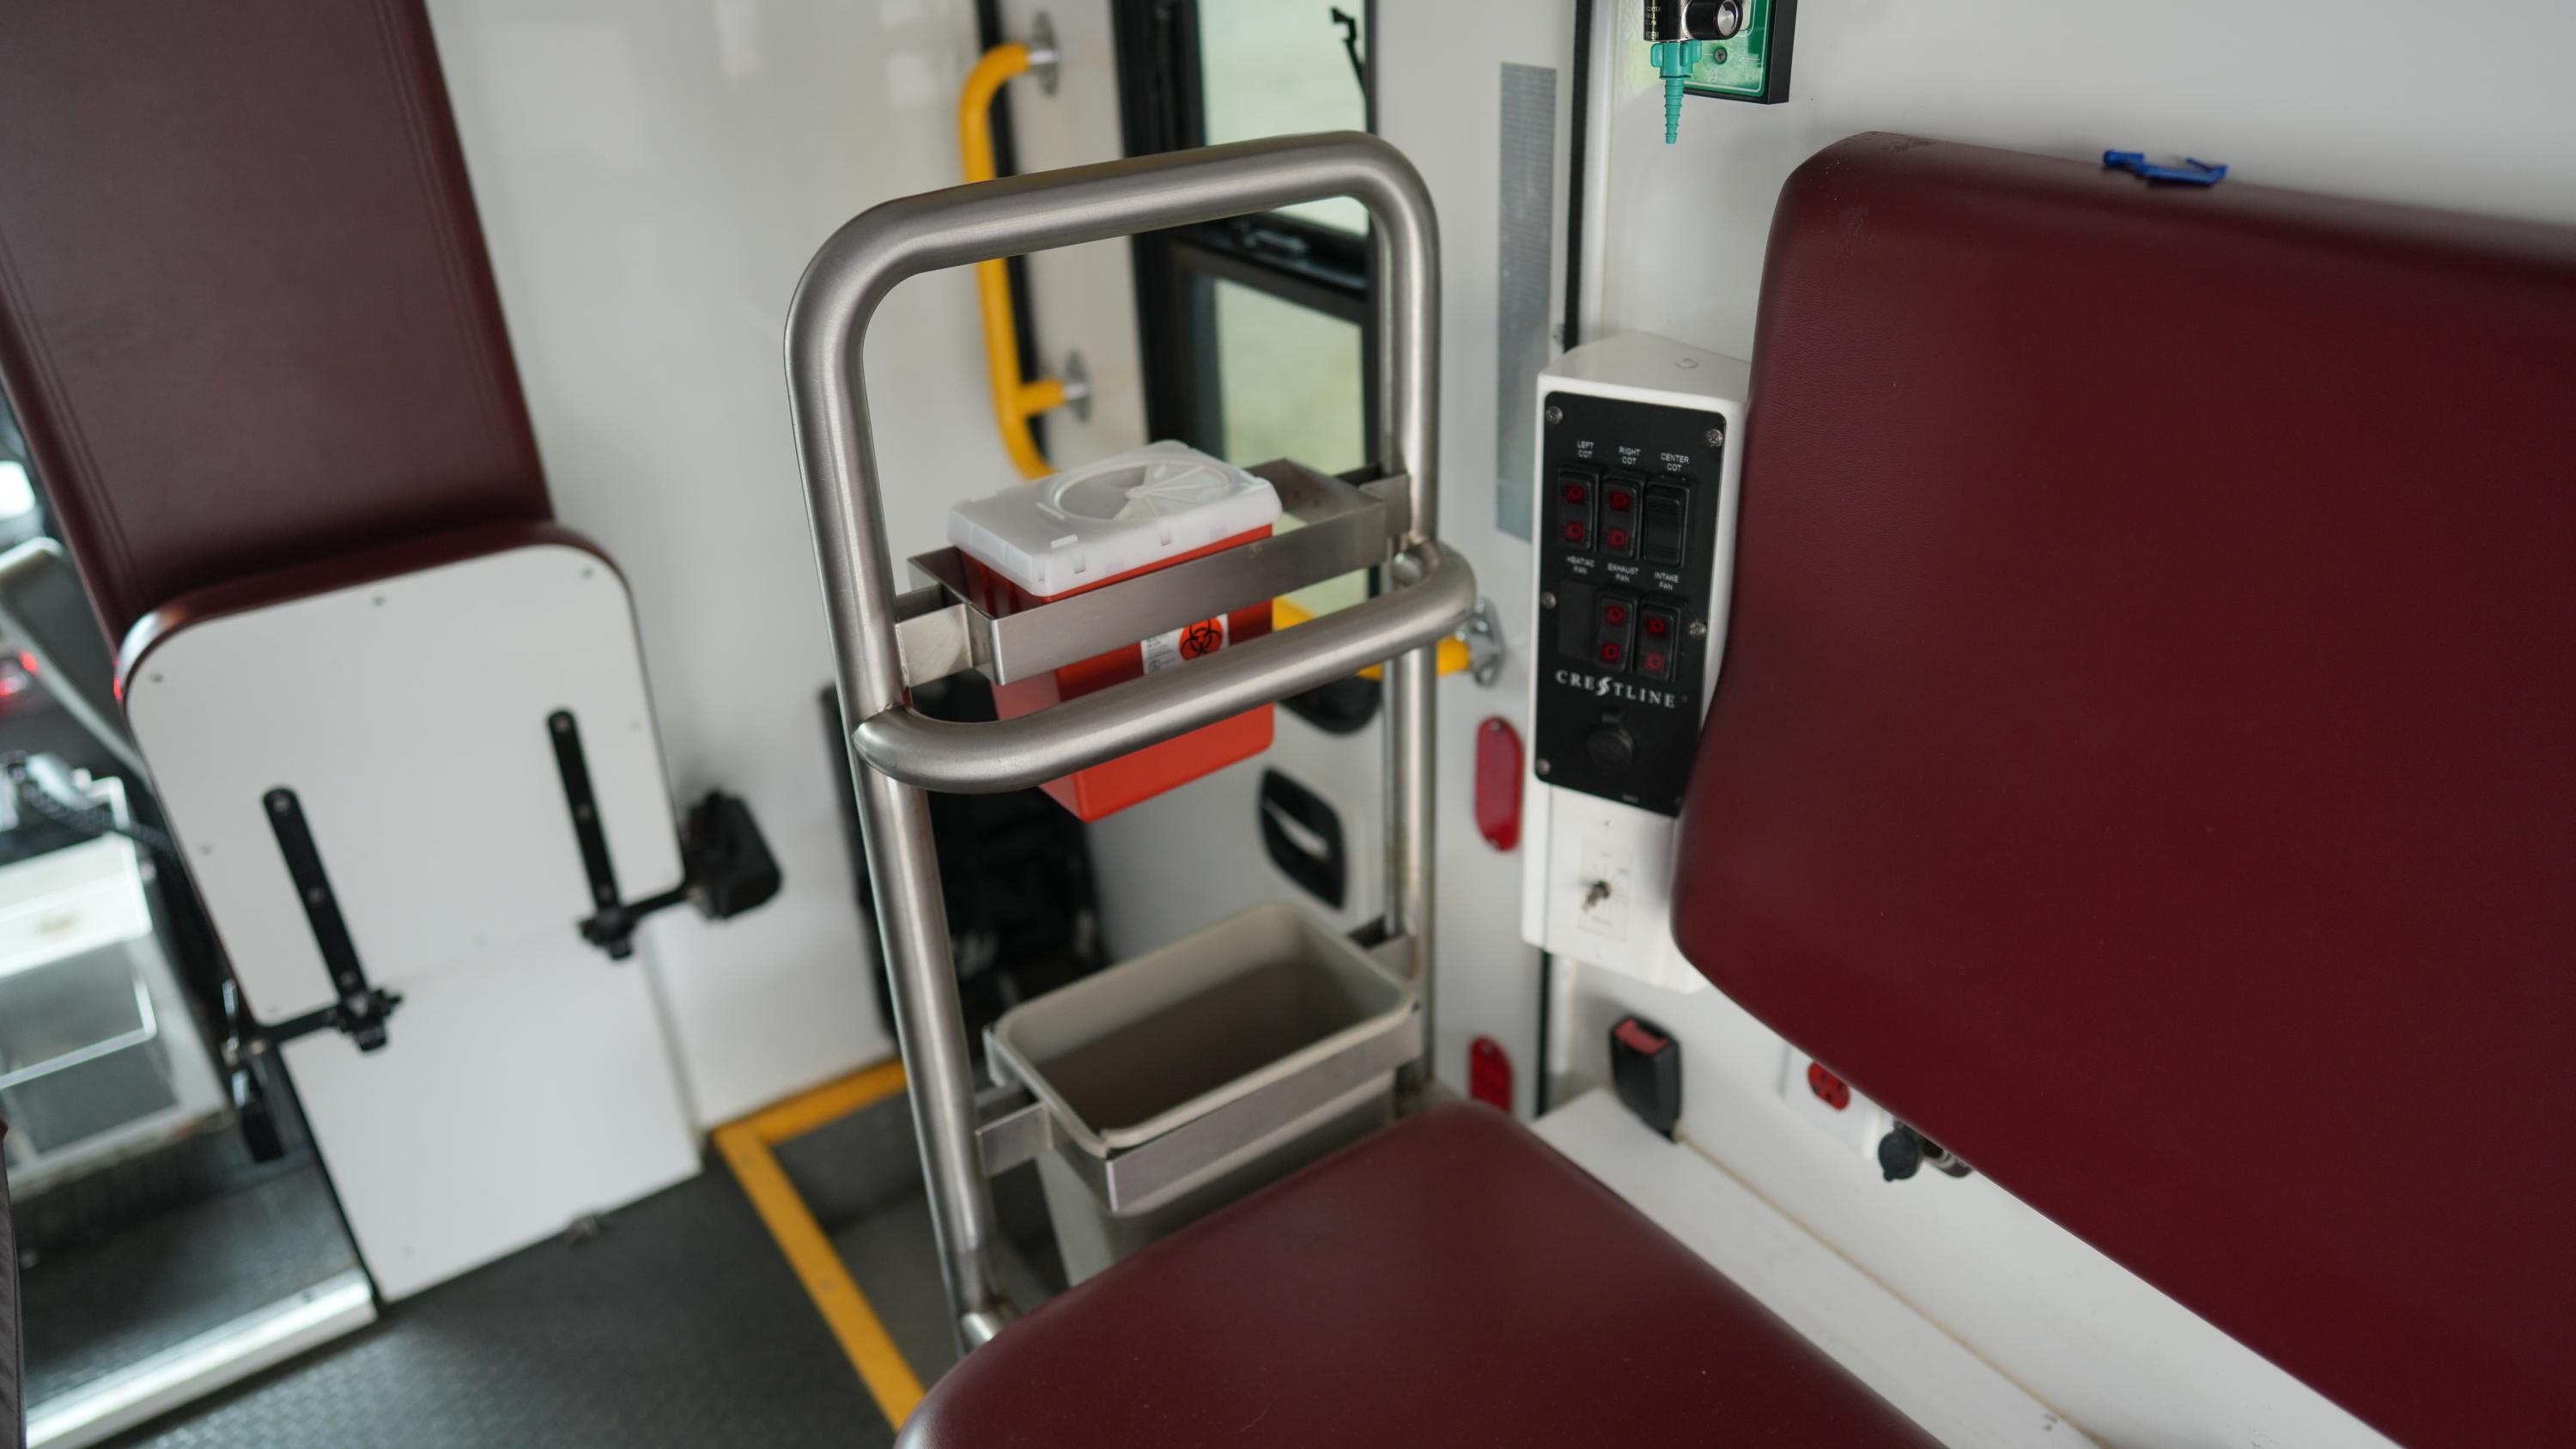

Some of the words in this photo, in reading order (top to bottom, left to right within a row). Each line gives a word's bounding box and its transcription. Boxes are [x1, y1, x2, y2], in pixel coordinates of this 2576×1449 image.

[1577, 440, 1595, 449] LEFT
[1578, 449, 1593, 459] COT
[1619, 446, 1641, 456] RIGHT
[1622, 456, 1637, 465] COT
[1661, 453, 1690, 464] CENTER
[1667, 463, 1683, 472] COT
[1573, 565, 1588, 575] FAN
[1607, 563, 1639, 575] EXHAUST
[1615, 573, 1631, 582] FAN
[1654, 571, 1680, 583] INTAKE
[1659, 581, 1674, 590] FAN
[1555, 669, 1675, 708] CRESTLINE
